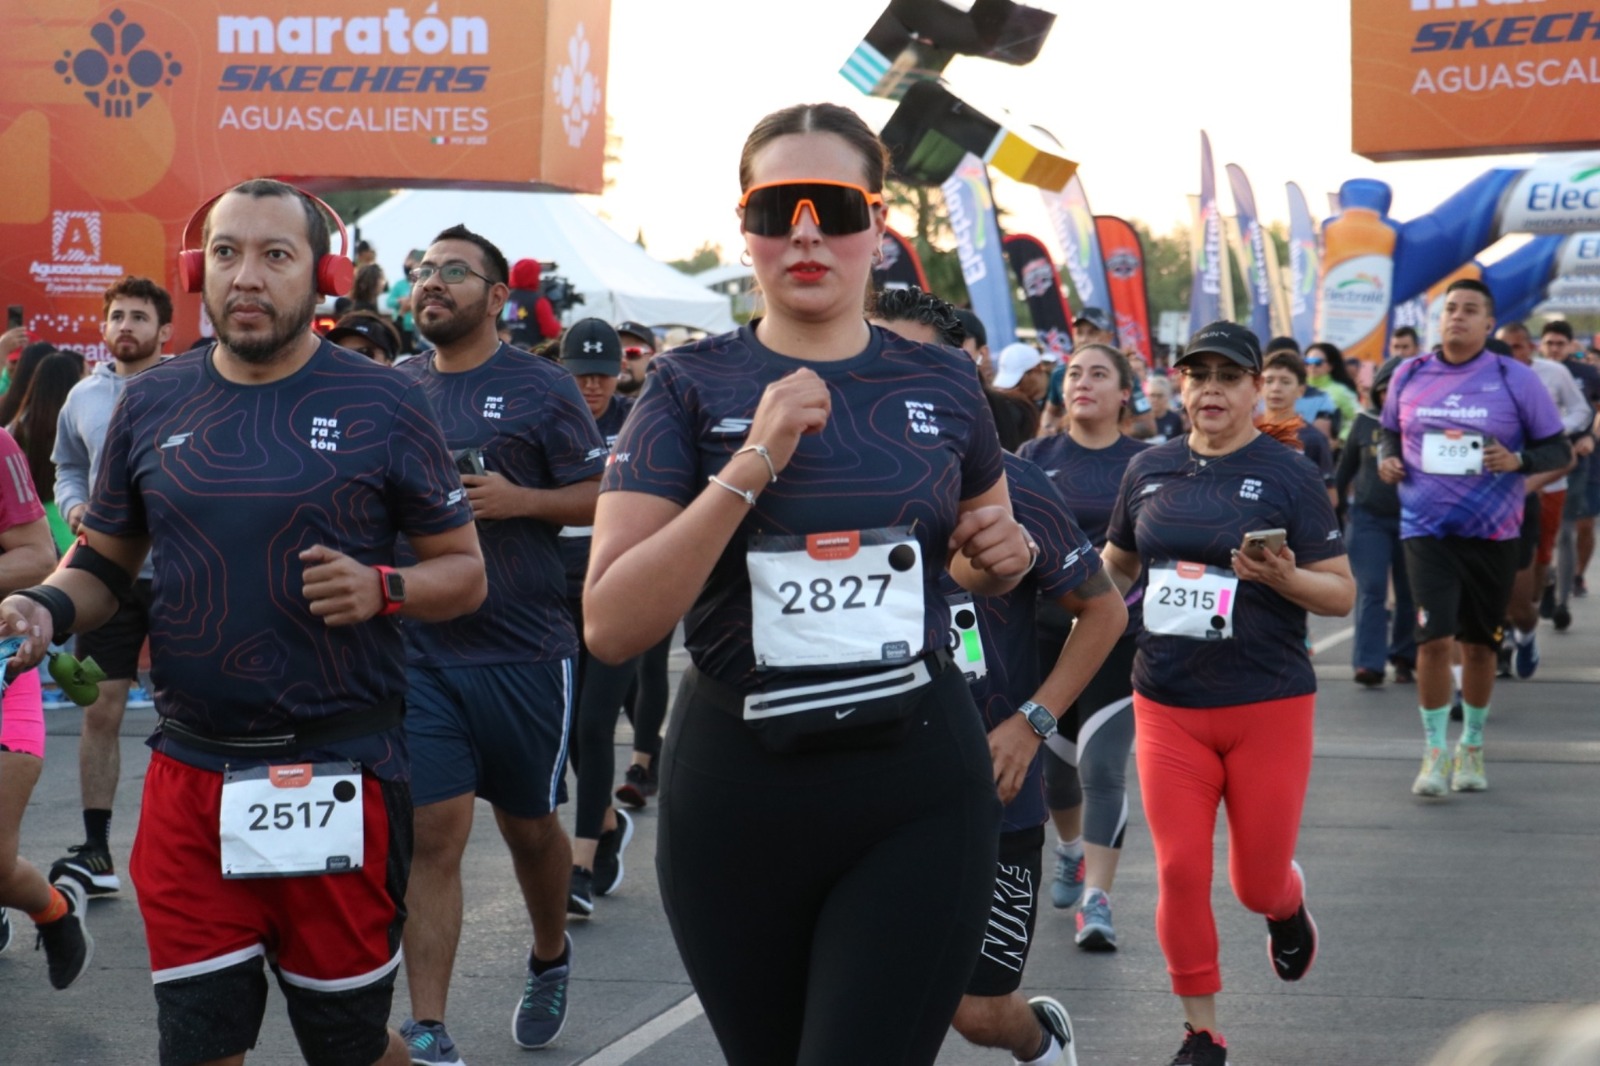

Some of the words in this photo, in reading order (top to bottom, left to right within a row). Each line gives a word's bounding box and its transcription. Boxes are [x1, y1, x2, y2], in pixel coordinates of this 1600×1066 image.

[216, 2, 489, 54] maratón
[216, 65, 491, 93] SKECHERS
[218, 106, 489, 132] AGUASCALIENTES
[312, 416, 338, 428] ma
[908, 409, 928, 420] ra
[1416, 405, 1488, 419] maratón
[311, 427, 329, 438] ra
[911, 421, 940, 437] tón
[309, 438, 337, 452] tón
[1438, 445, 1470, 458] 269
[778, 573, 892, 615] 2827
[1158, 586, 1215, 611] 2315
[248, 800, 336, 831] 2517
[980, 860, 1034, 973] NIKE
